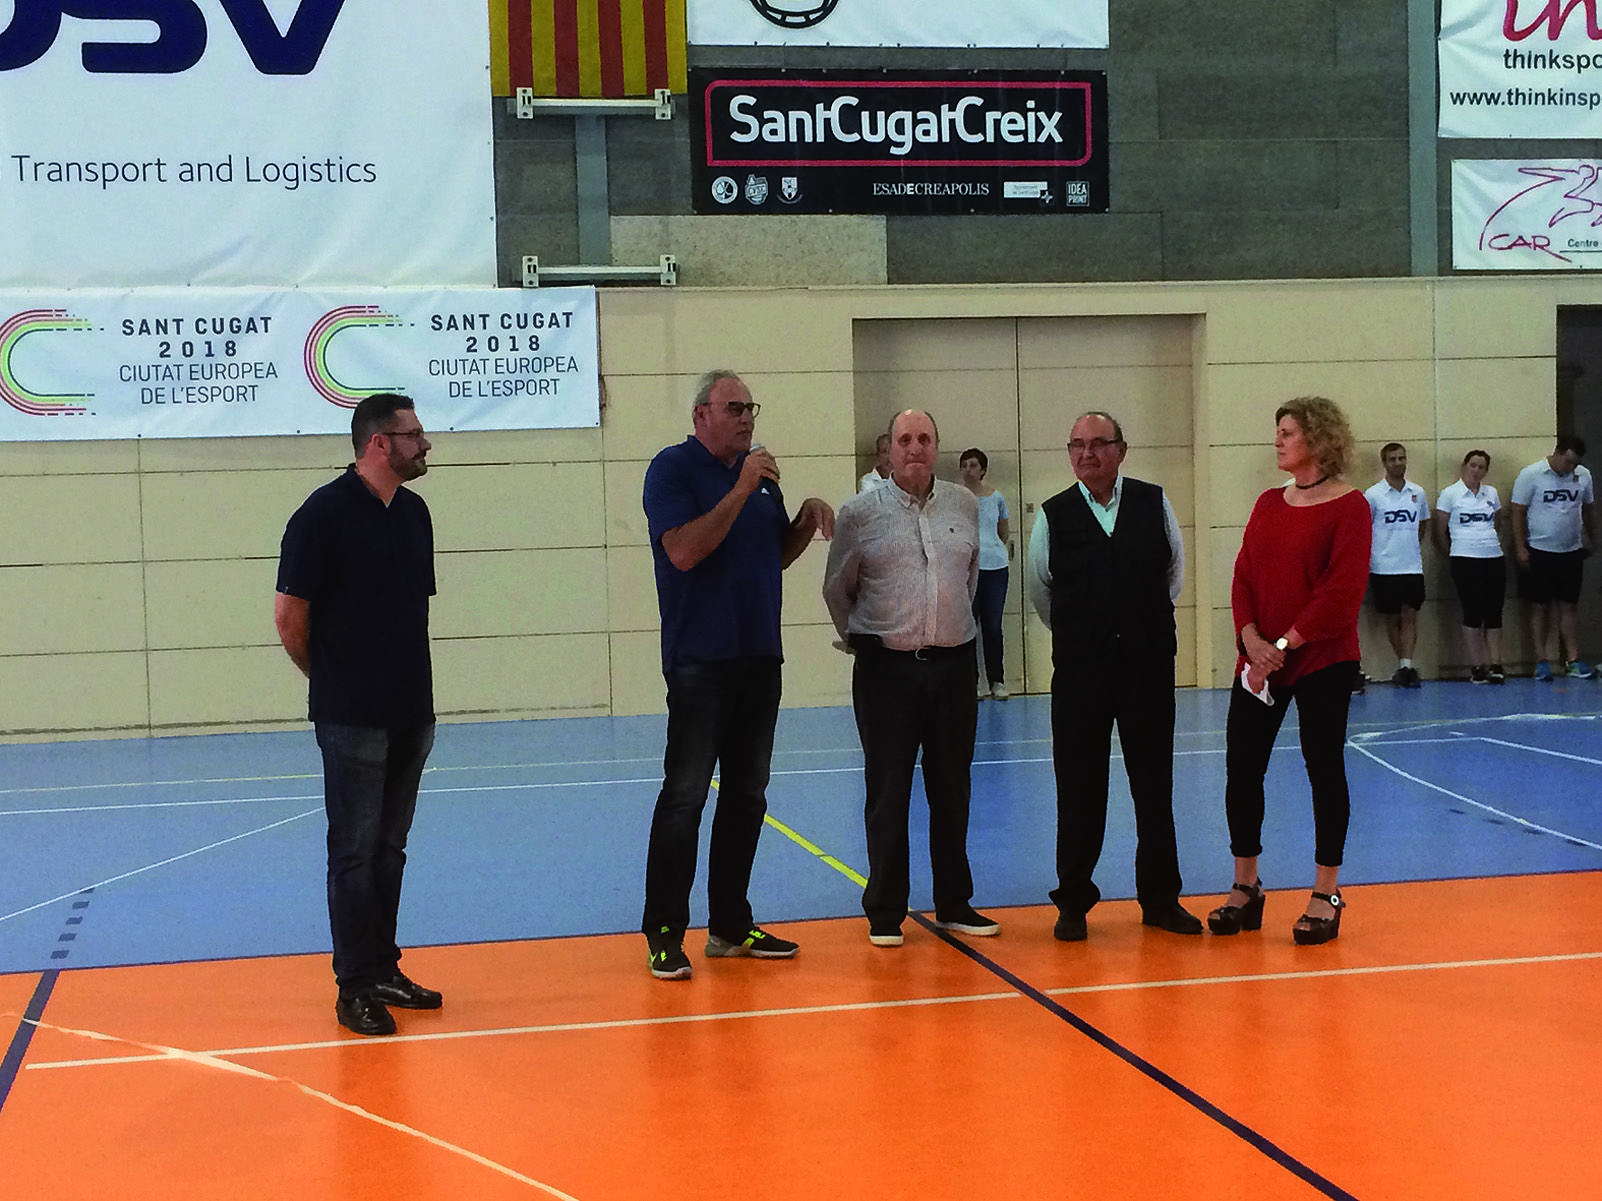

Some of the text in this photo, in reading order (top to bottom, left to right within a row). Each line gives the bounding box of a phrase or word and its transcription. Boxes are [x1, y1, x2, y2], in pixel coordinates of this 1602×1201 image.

[1450, 88, 1601, 110] www.thinkinsp
[729, 94, 1063, 155] SantCugatCreix
[11, 155, 377, 191] Transport and Logistics
[872, 182, 990, 196] ESADECREAPOLIS
[1068, 183, 1087, 194] IDEA
[1488, 233, 1572, 262] CAR
[122, 316, 271, 336] SANT CUGAT
[432, 312, 573, 331] SANT CUGAT
[159, 340, 237, 358] 2018
[466, 335, 540, 353] 2018
[119, 361, 279, 382] CIUTAT EUROPEA
[428, 356, 579, 376] CIUTAT EUROPEA
[141, 384, 259, 405] DE L'ESPORT
[449, 378, 560, 398] DE L'ESPORT
[1543, 489, 1579, 502] DSV
[1384, 509, 1417, 524] DSV
[1459, 512, 1494, 524] DSV
